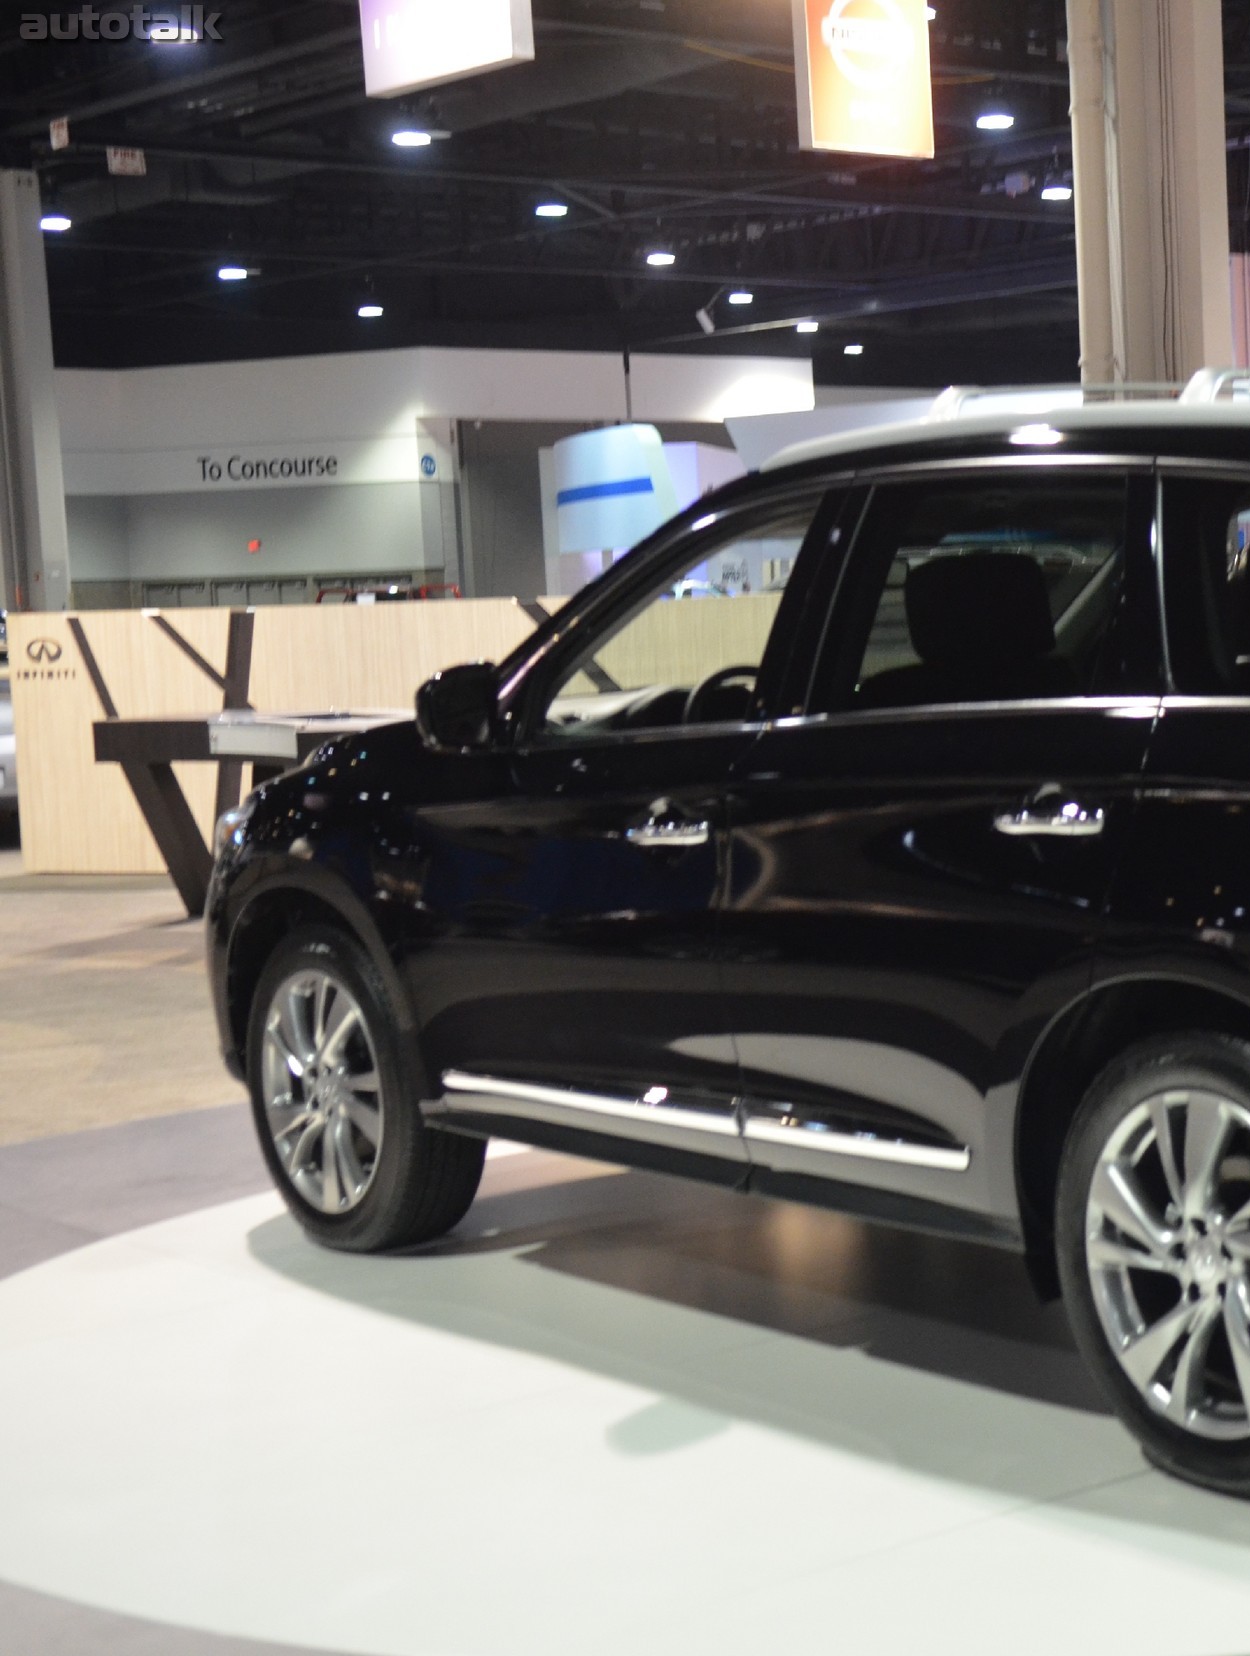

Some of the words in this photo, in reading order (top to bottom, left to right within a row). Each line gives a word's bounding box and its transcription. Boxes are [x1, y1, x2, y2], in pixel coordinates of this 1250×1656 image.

[197, 456, 222, 482] To
[227, 455, 338, 481] Concourse
[16, 669, 76, 680] INFINITI
